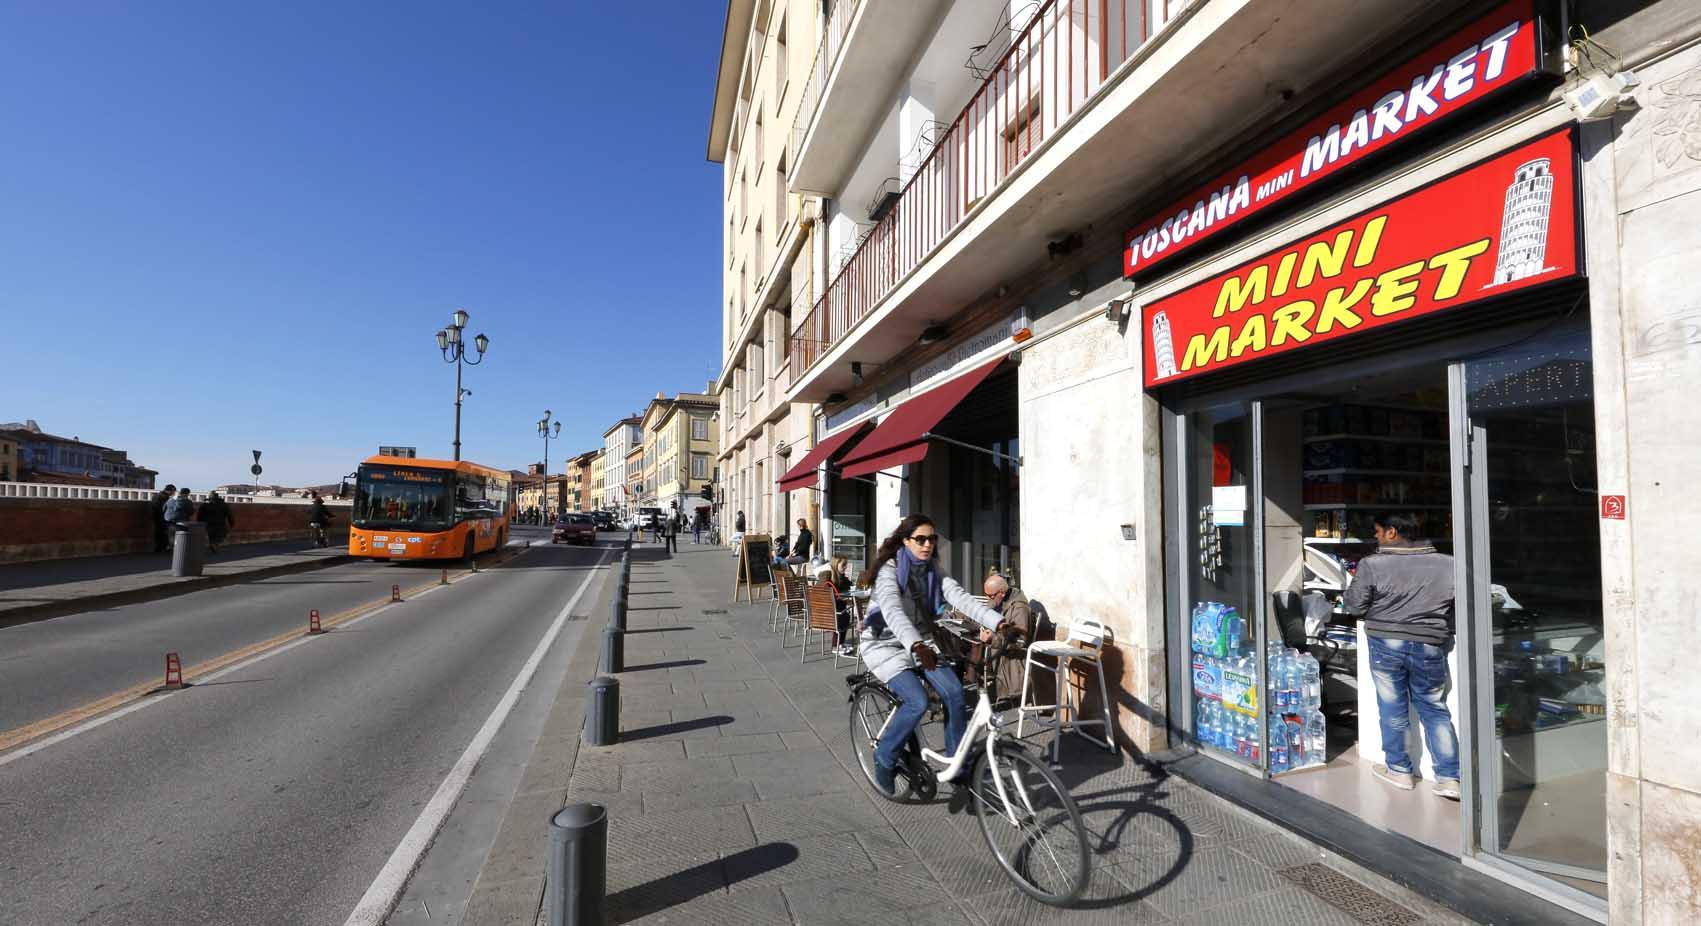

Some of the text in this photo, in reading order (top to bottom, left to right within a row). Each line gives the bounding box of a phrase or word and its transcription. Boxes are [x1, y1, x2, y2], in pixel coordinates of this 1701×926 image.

[1129, 21, 1520, 267] TOSCANA MINI MARKET
[1180, 238, 1491, 372] MARKET
[1212, 214, 1388, 318] MINI
